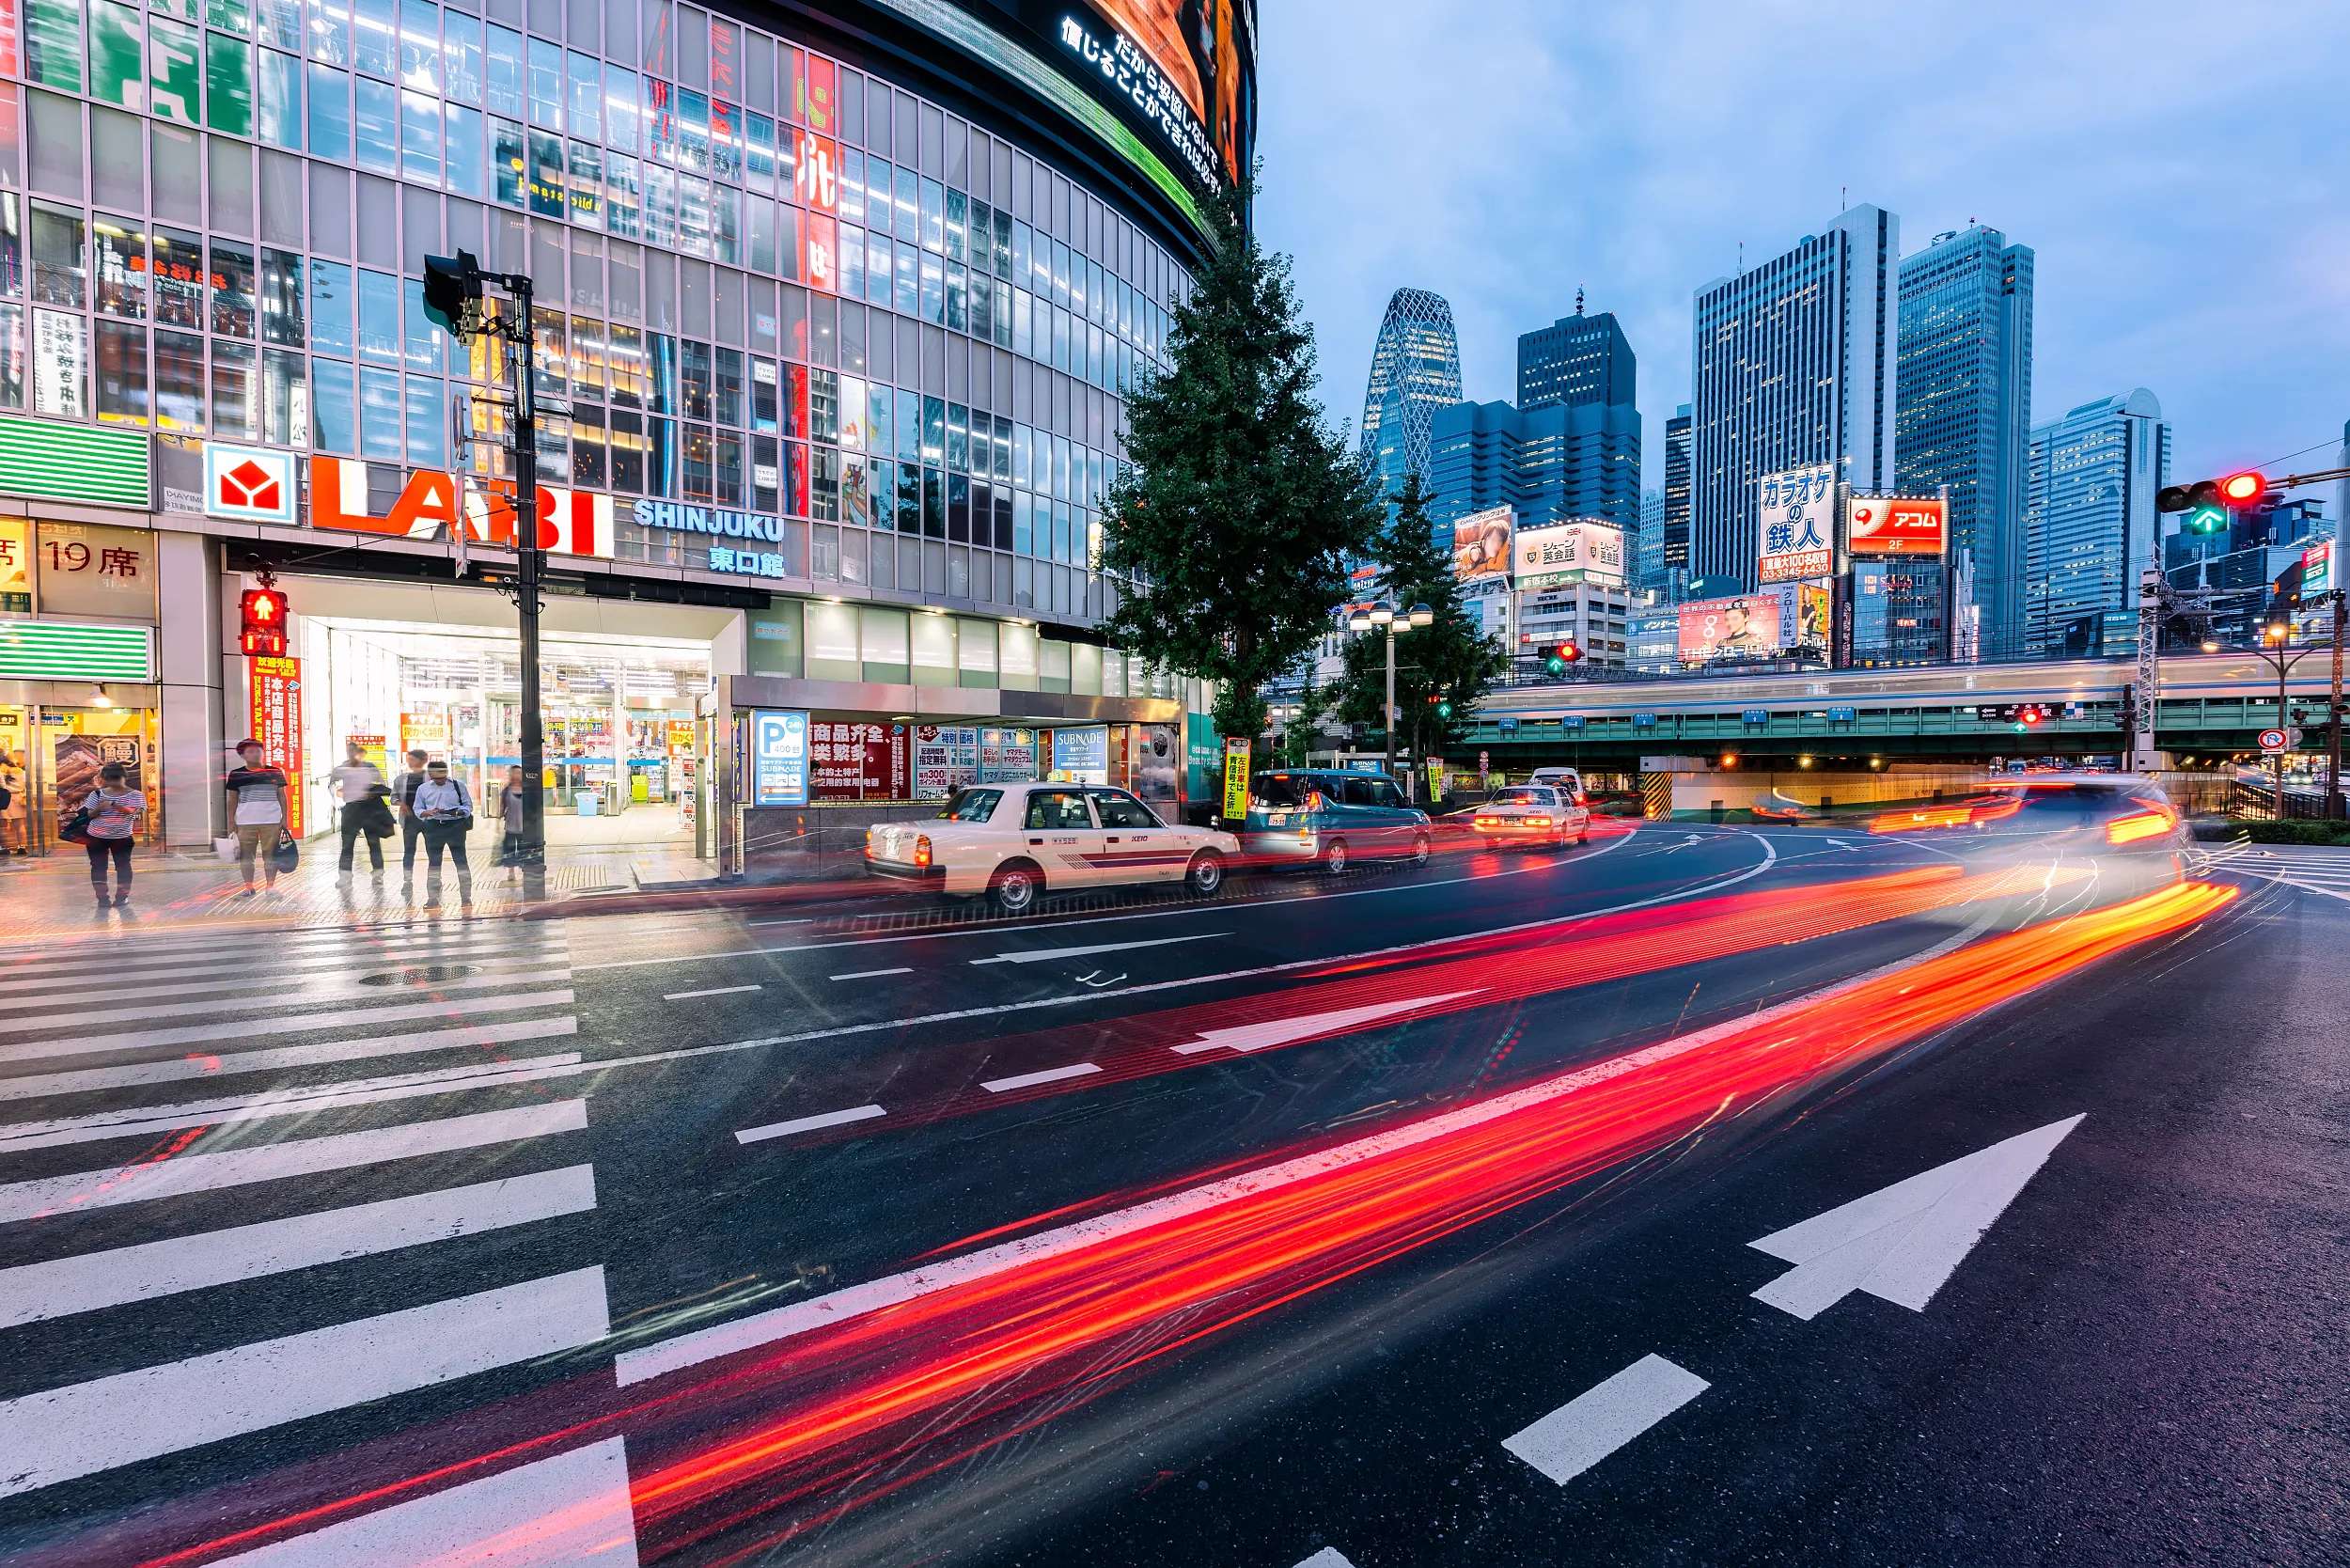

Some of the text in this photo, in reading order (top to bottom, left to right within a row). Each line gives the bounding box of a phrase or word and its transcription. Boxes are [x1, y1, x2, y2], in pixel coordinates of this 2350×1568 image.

[1115, 32, 1219, 171] だから妥協しないで
[1762, 470, 1832, 510] カラオケ
[311, 456, 614, 558] LABI
[633, 498, 785, 542] SHINJUKU
[1788, 502, 1804, 524] の
[1894, 512, 1937, 527] アコム
[1543, 539, 1575, 552] シェーン
[1766, 516, 1825, 555] 鉄人
[1888, 540, 1904, 550] 2F
[709, 546, 785, 578] 東口館
[1543, 551, 1575, 563] 英会話
[1762, 564, 1828, 579] 03-3345-6430
[1782, 592, 1793, 637] グローバル社
[763, 722, 786, 754] P
[808, 723, 891, 745] 商品齐全、
[1058, 731, 1103, 746] SUBNADE
[808, 743, 875, 761] 类繁多。
[813, 767, 861, 777] 本的土特产
[1227, 755, 1238, 809] 青信号で左折
[1236, 756, 1247, 792] 左折車は
